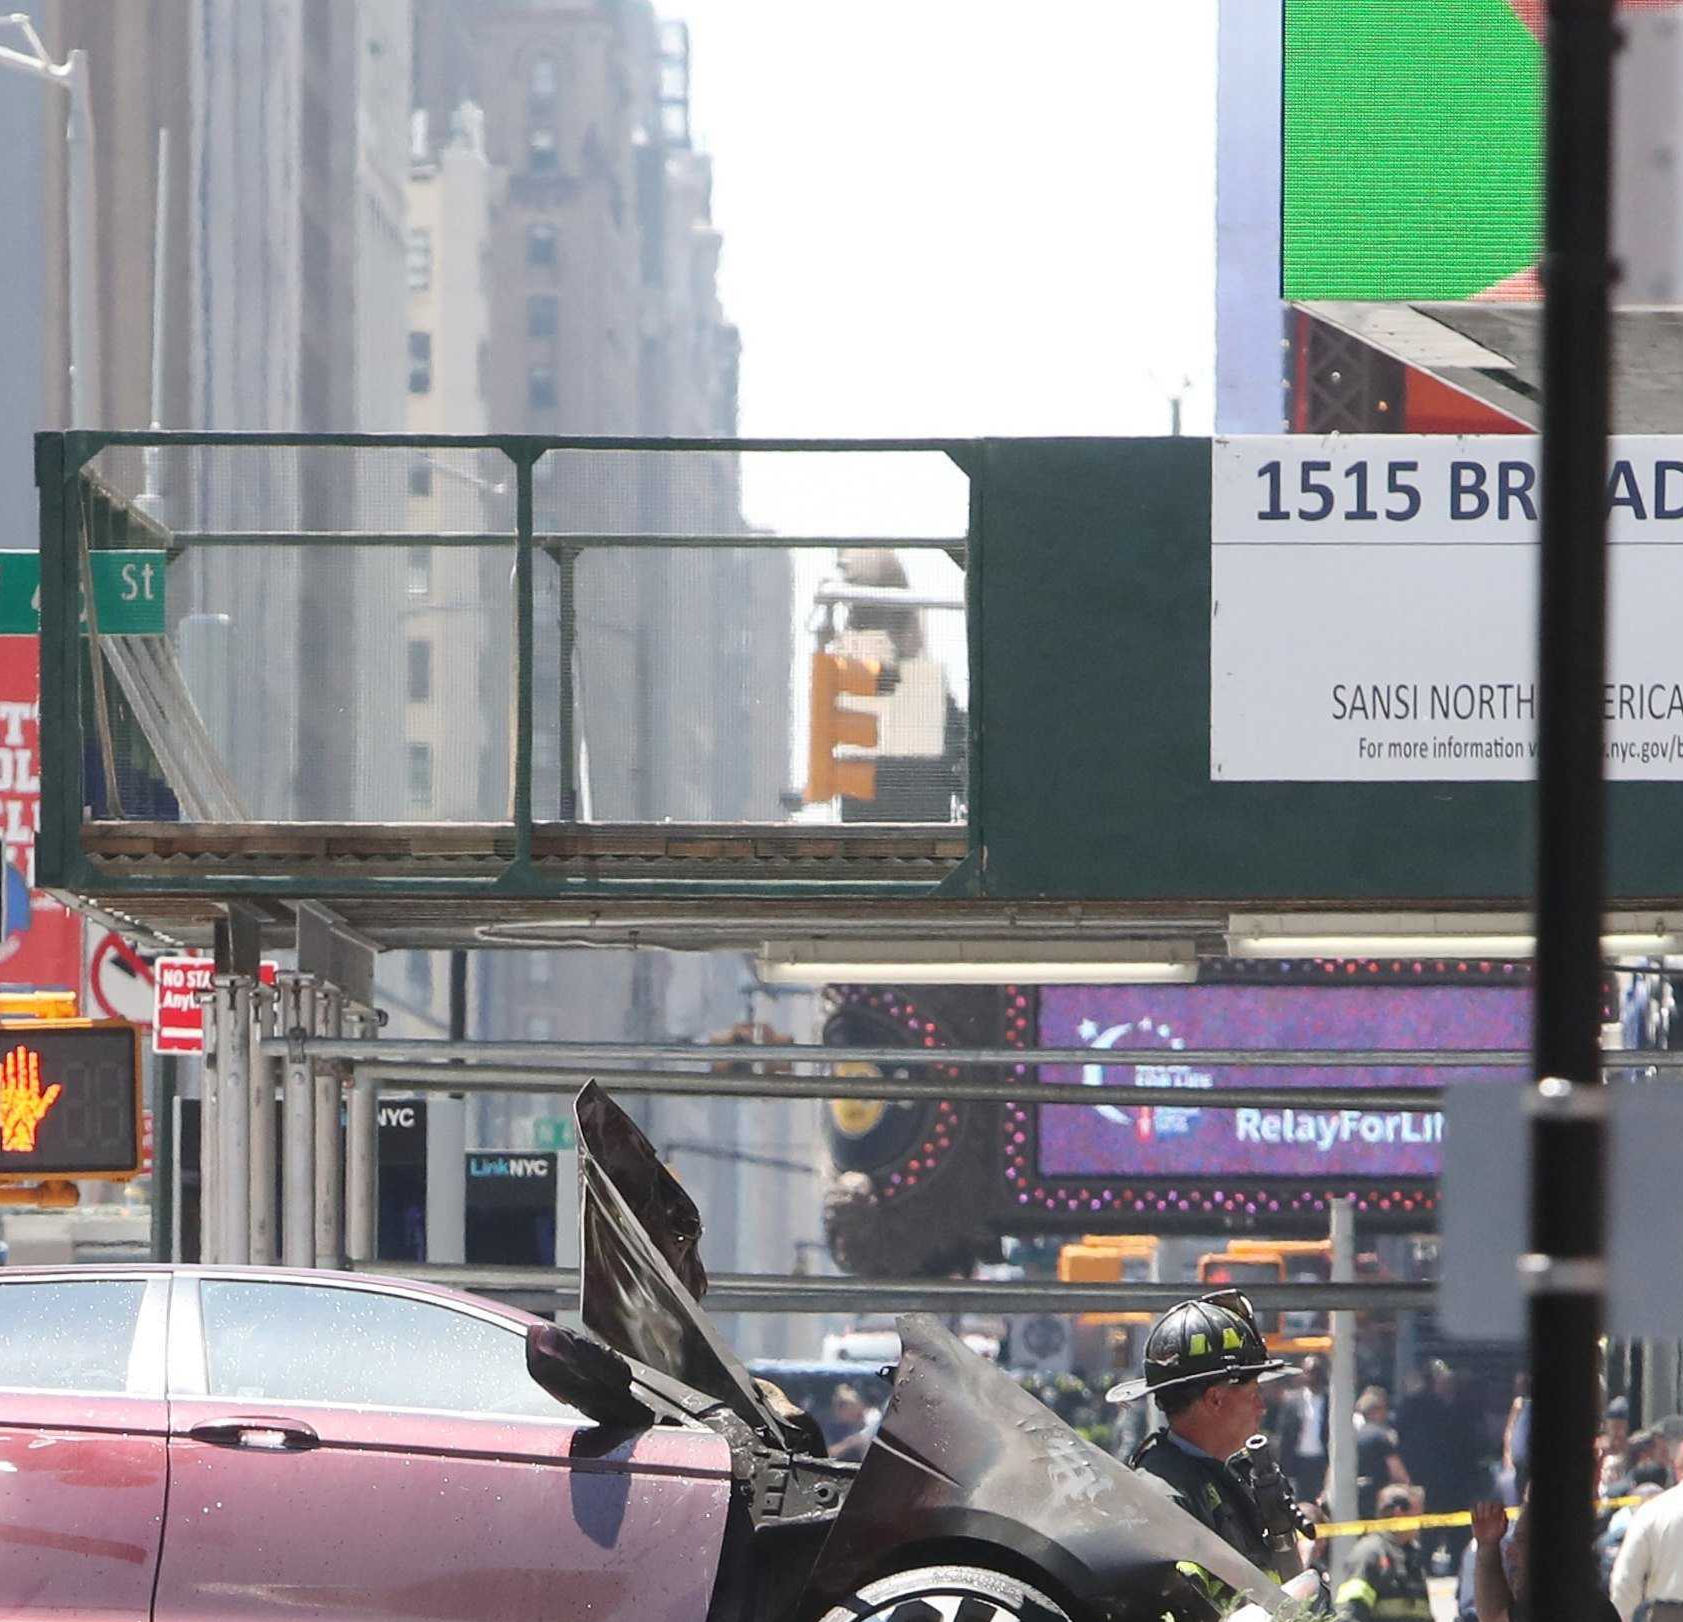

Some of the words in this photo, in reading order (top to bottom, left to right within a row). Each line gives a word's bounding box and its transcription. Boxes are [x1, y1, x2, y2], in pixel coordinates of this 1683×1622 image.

[1256, 460, 1423, 523] 1515
[121, 562, 155, 601] St
[1332, 684, 1419, 720] SANSI
[1429, 684, 1535, 720] NORTH
[1359, 737, 1383, 759] For
[1388, 741, 1428, 759] more
[1433, 735, 1524, 759] information
[162, 969, 185, 989] NO
[1235, 1107, 1445, 1151] RelayForLif
[470, 1158, 549, 1178] LinkNYC
